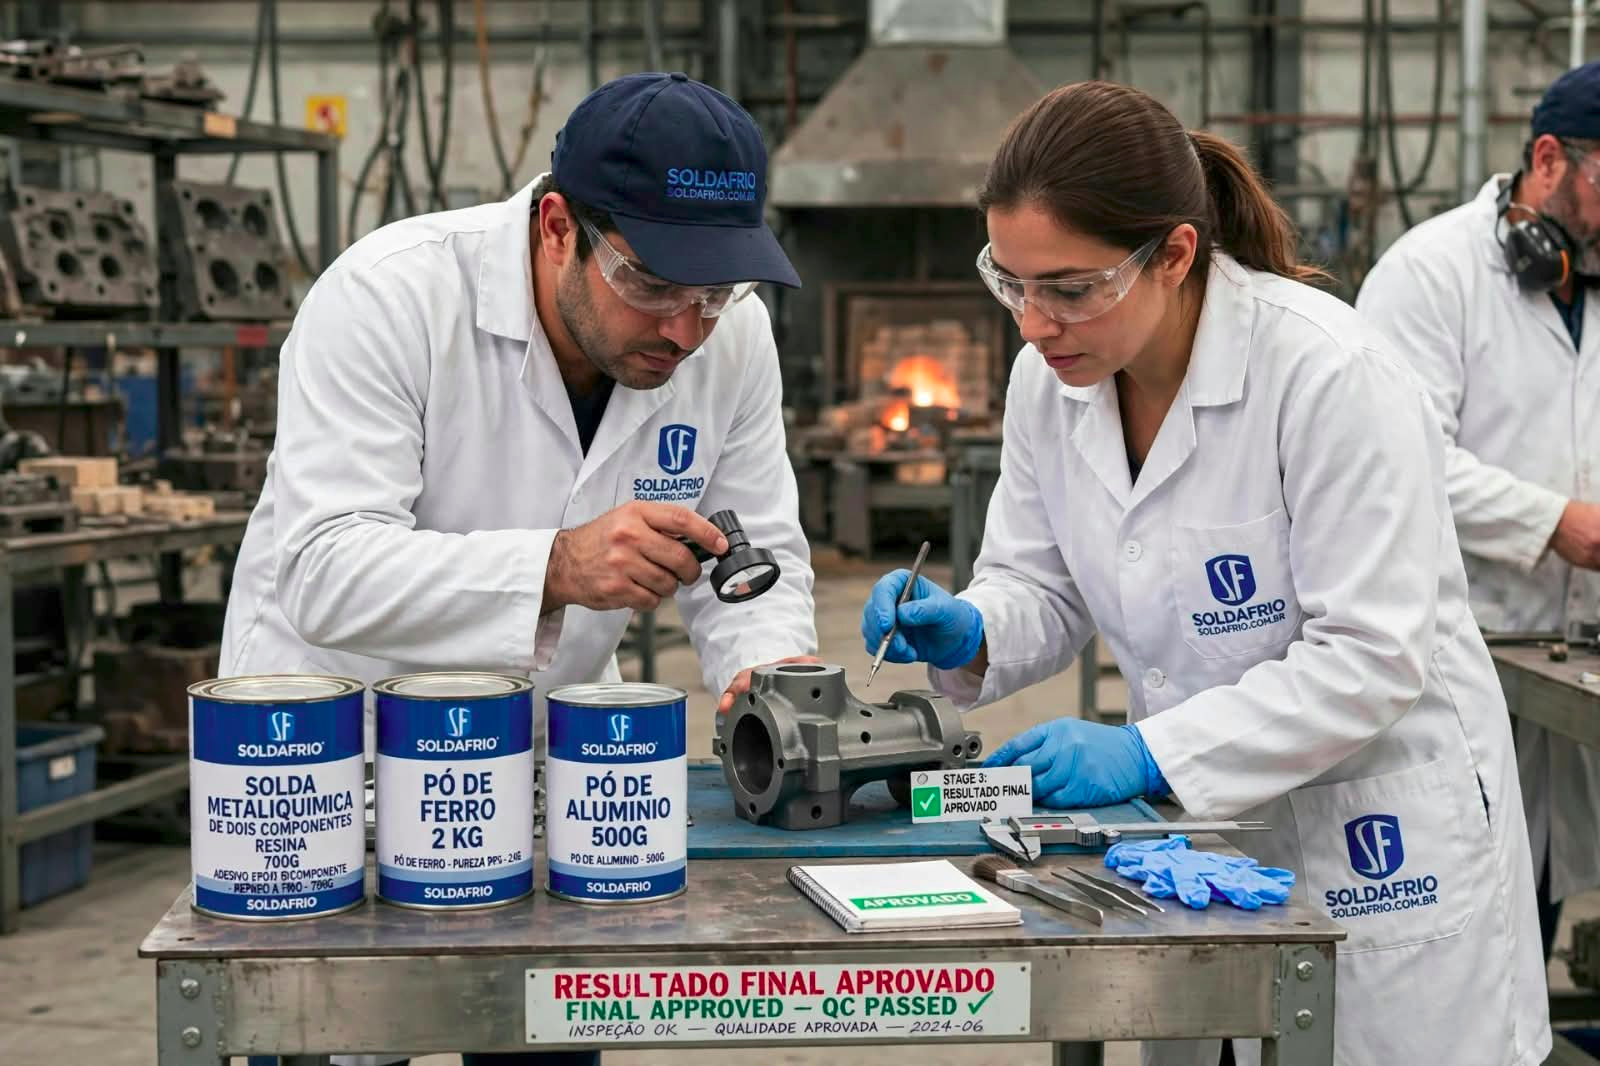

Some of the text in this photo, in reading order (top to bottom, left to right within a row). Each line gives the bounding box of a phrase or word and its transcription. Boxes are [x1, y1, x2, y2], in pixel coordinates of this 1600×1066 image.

[667, 168, 756, 189] SOLDAFRIO
[633, 477, 704, 492] SOLDAFRIO
[1192, 599, 1285, 626] SOLDAFRIO
[1198, 612, 1285, 636] SOLDAFRIO.COM.BR
[238, 742, 322, 758] SOLDAFRIO
[417, 738, 497, 752] SOLDAFRIO
[581, 742, 656, 756] SOLDAFRIO
[245, 774, 316, 796] SOLDA
[424, 768, 493, 796] PÓ DE
[586, 770, 652, 797] PÓ DE
[943, 773, 987, 785] STAGE 3:
[943, 784, 1030, 800] RESULTADO FINAL
[208, 790, 353, 820] METALIQUIMICA
[421, 798, 496, 822] FERRO
[566, 797, 671, 822] ALUMINIO
[944, 800, 997, 814] APROVADO
[209, 813, 352, 836] DE DOIS COMPONENTES
[255, 837, 307, 853] RESINA
[432, 826, 483, 849] 2 KG
[592, 825, 648, 847] 500G
[264, 854, 299, 869] 700G
[406, 857, 417, 868] DE
[419, 858, 446, 870] FERRO
[453, 858, 485, 869] PUREZA
[583, 855, 594, 865] DE
[424, 885, 493, 899] SOLDAFRIO
[587, 881, 651, 893] SOLDAFRIO
[1325, 875, 1438, 907] SOLDAFRIO
[246, 897, 318, 911] SOLDAFRIO
[863, 893, 973, 907] APROVADO
[1331, 894, 1438, 918] SOLDAFRIO.COM.BR
[555, 968, 995, 1000] RESULTADO FINAL APROVADO
[566, 1000, 640, 1021] FINAL
[650, 998, 784, 1020] APPROVED
[822, 997, 855, 1019] QC
[865, 996, 957, 1016] PASSED
[568, 1021, 645, 1039] INSPEÇÃO
[654, 1023, 678, 1036] OK
[715, 1022, 797, 1035] QUALIDADE
[804, 1021, 878, 1034] APROVADA
[910, 1019, 984, 1034] 2024-06
